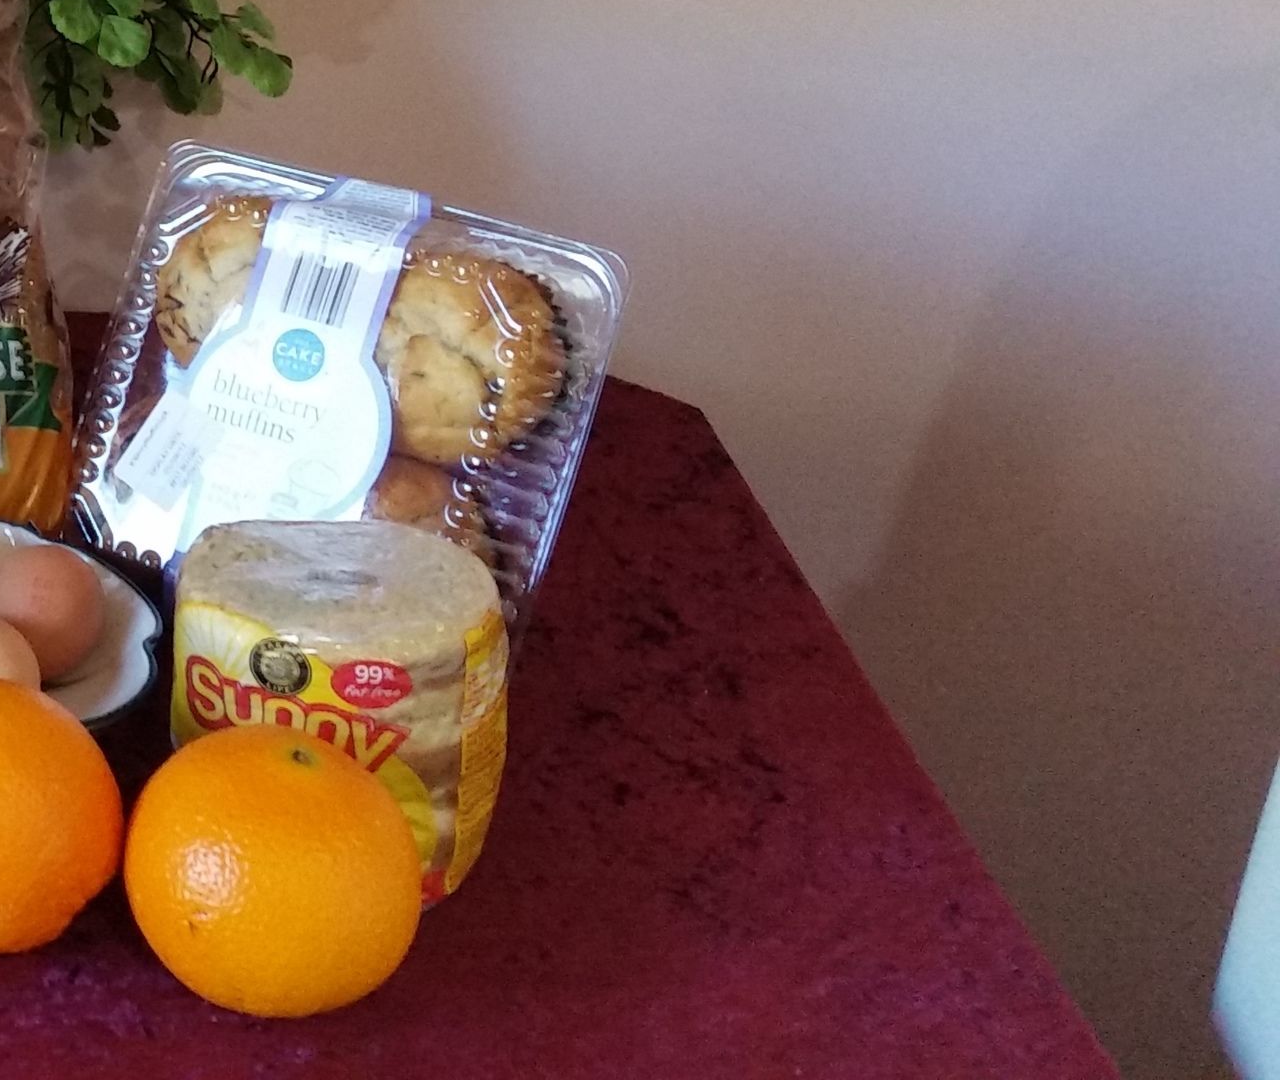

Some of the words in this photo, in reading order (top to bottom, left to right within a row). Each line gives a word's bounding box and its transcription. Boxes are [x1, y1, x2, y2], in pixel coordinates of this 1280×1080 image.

[275, 341, 323, 367] CAKE
[212, 368, 328, 425] blueberry
[206, 398, 296, 447] muffins
[190, 658, 407, 771] Sunny
[343, 684, 368, 698] fat
[369, 686, 402, 699] free
